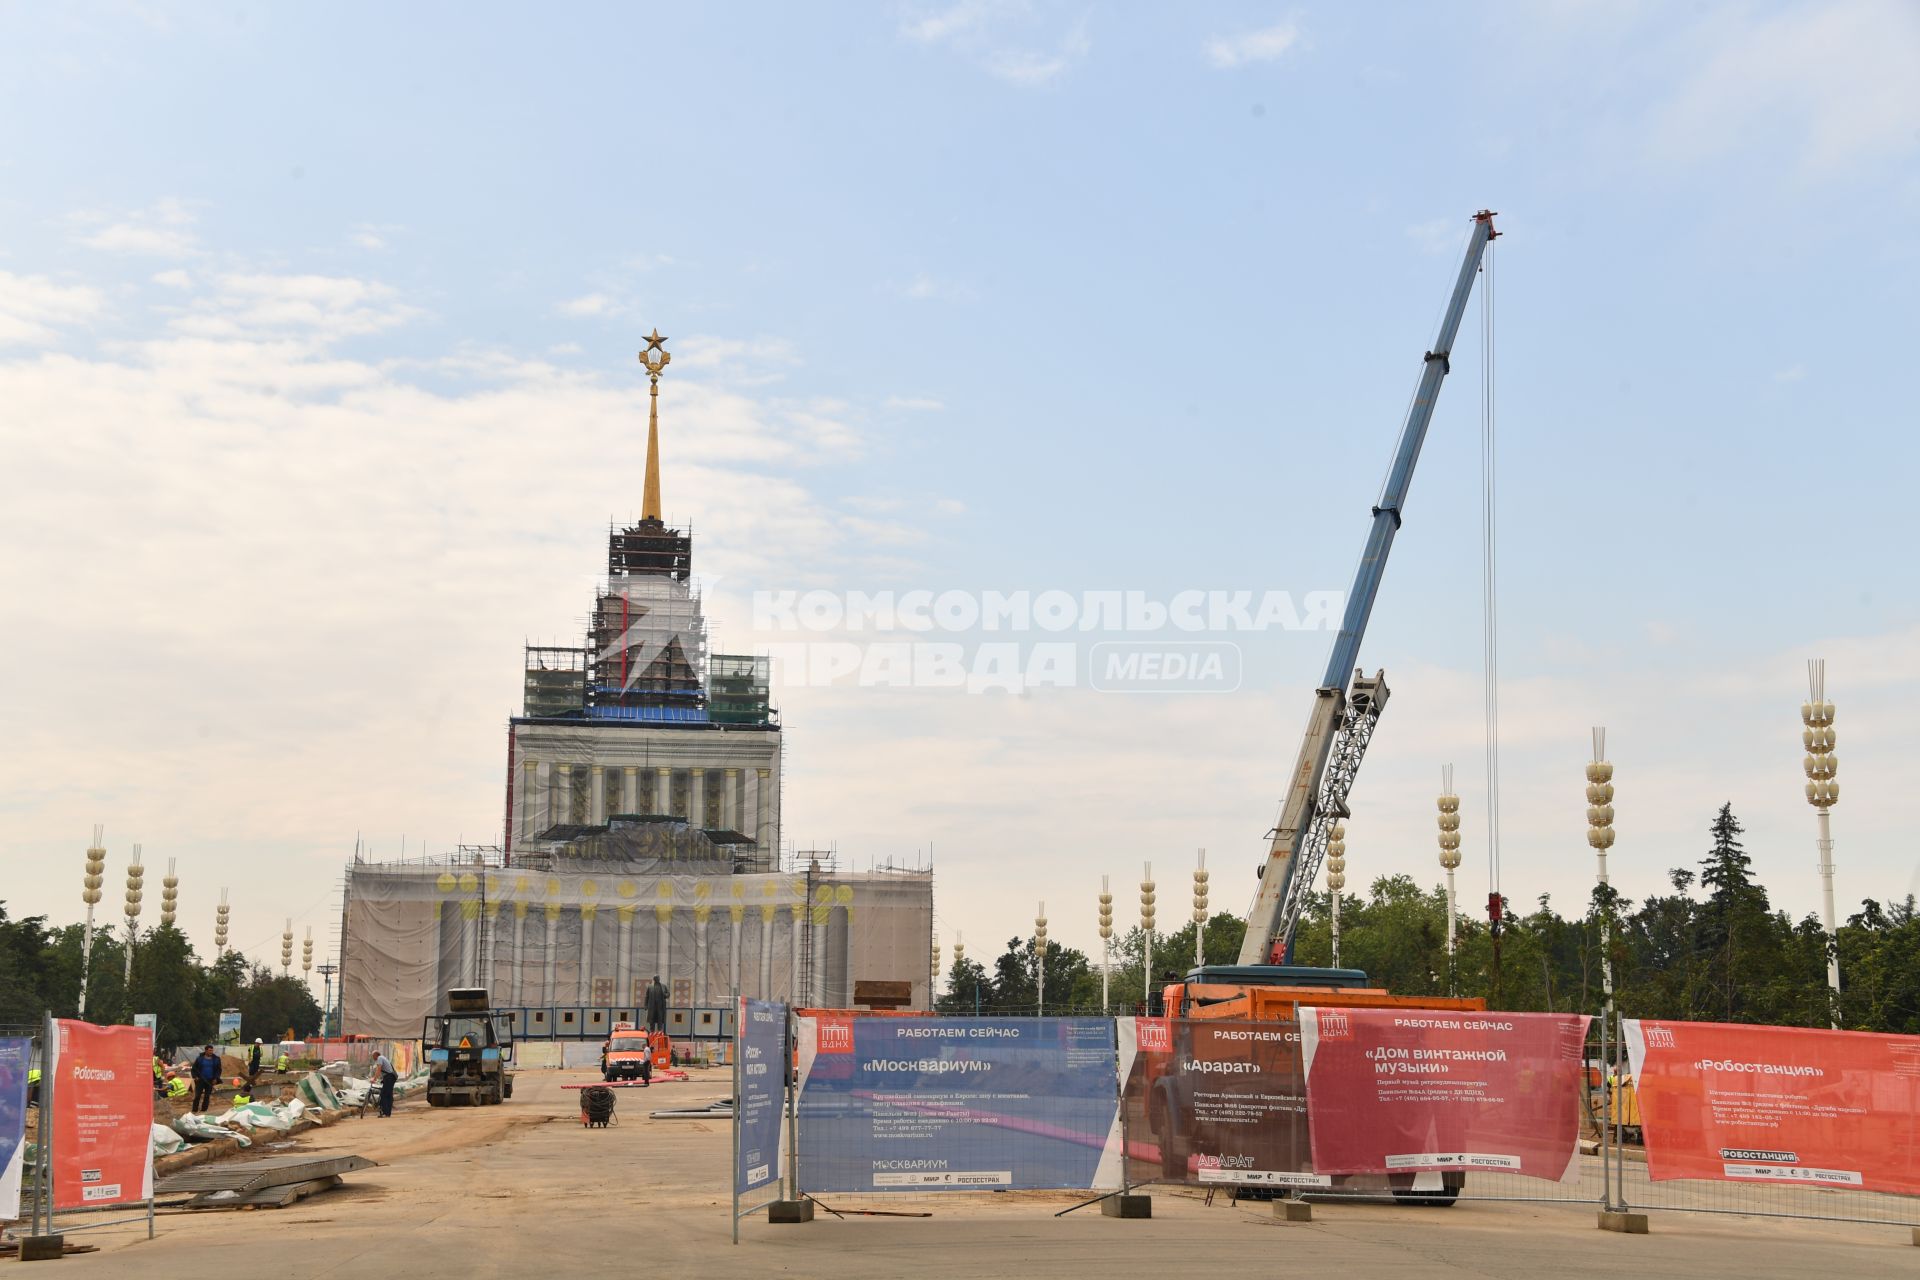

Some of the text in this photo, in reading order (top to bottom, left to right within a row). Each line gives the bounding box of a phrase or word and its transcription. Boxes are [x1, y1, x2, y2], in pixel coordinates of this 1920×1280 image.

[1394, 1018, 1513, 1031] РАБОТАЕМ СЕЙЧАС
[897, 1026, 1020, 1038] РАБОТАЕМ СЕЙЧАС
[1214, 1031, 1281, 1041] РАБОТАЕМ
[1323, 1028, 1349, 1037] ВДНХ
[821, 1040, 849, 1049] ВДНХ
[1141, 1039, 1168, 1048] ВДНХ
[1649, 1040, 1675, 1049] ВДНХ
[1365, 1047, 1506, 1062] «Дом винтажной
[863, 1059, 991, 1074] «Москвариум»
[1183, 1060, 1261, 1075] «Арарат»
[1375, 1062, 1449, 1075] музыки»
[1694, 1059, 1824, 1077] «Робостанция»
[1198, 1153, 1255, 1168] АРАРАТ
[1723, 1150, 1796, 1161] РОБОСТАНЦИЯ
[872, 1159, 948, 1169] МОСКВАРИУМ
[1471, 1158, 1511, 1166] РОСГОССТРАХ
